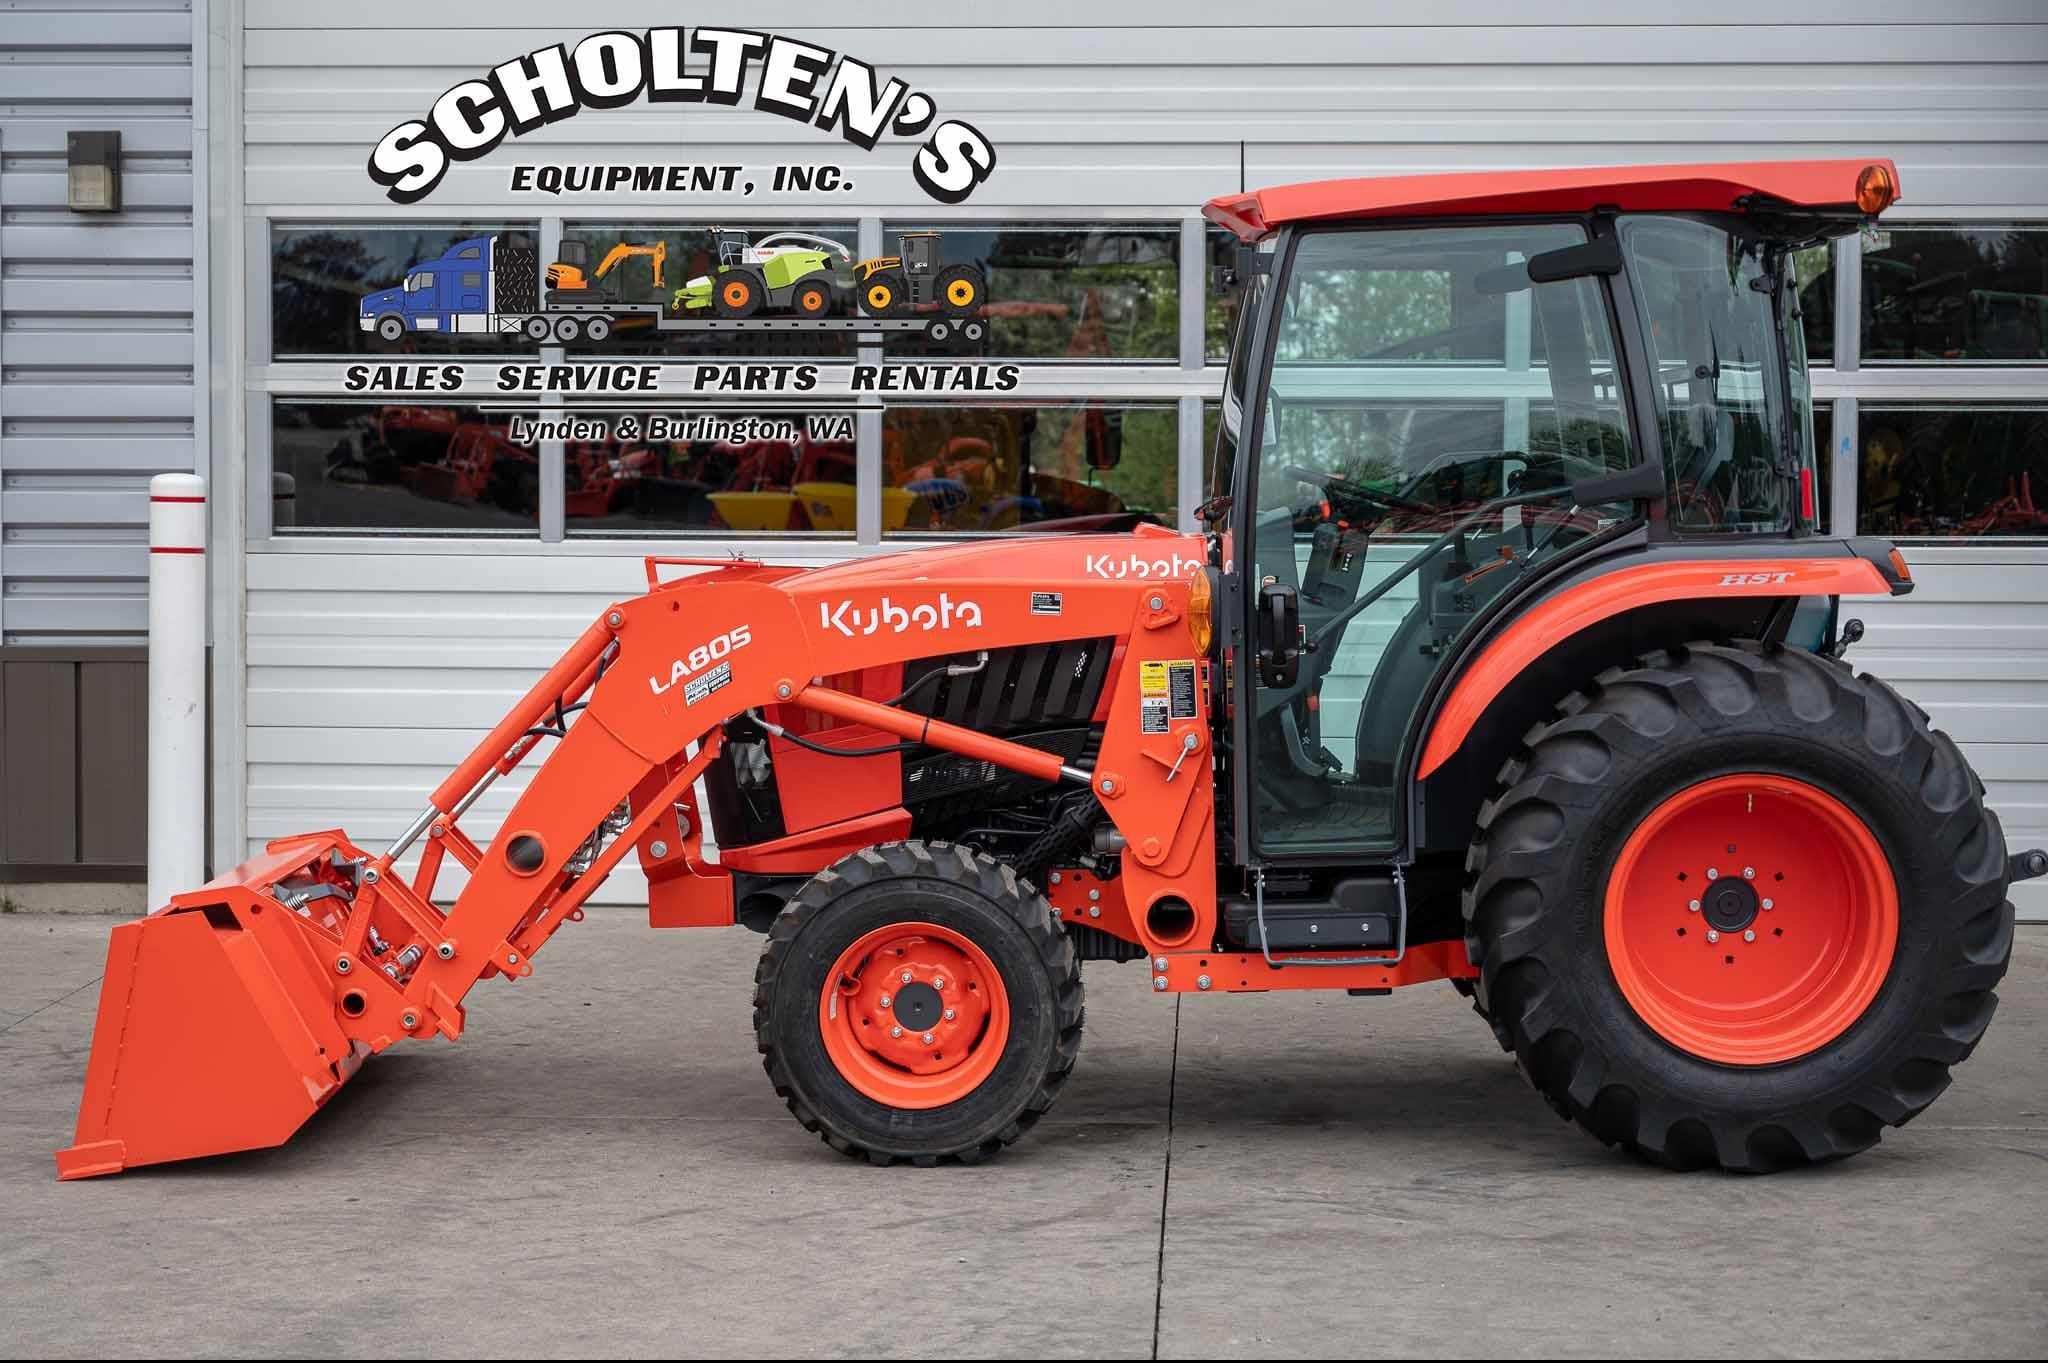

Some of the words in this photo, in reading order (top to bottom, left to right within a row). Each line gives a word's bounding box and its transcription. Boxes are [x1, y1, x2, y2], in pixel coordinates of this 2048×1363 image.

[1717, 572, 1797, 586] HST
[820, 592, 982, 637] Kubota
[649, 624, 752, 695] LA805
